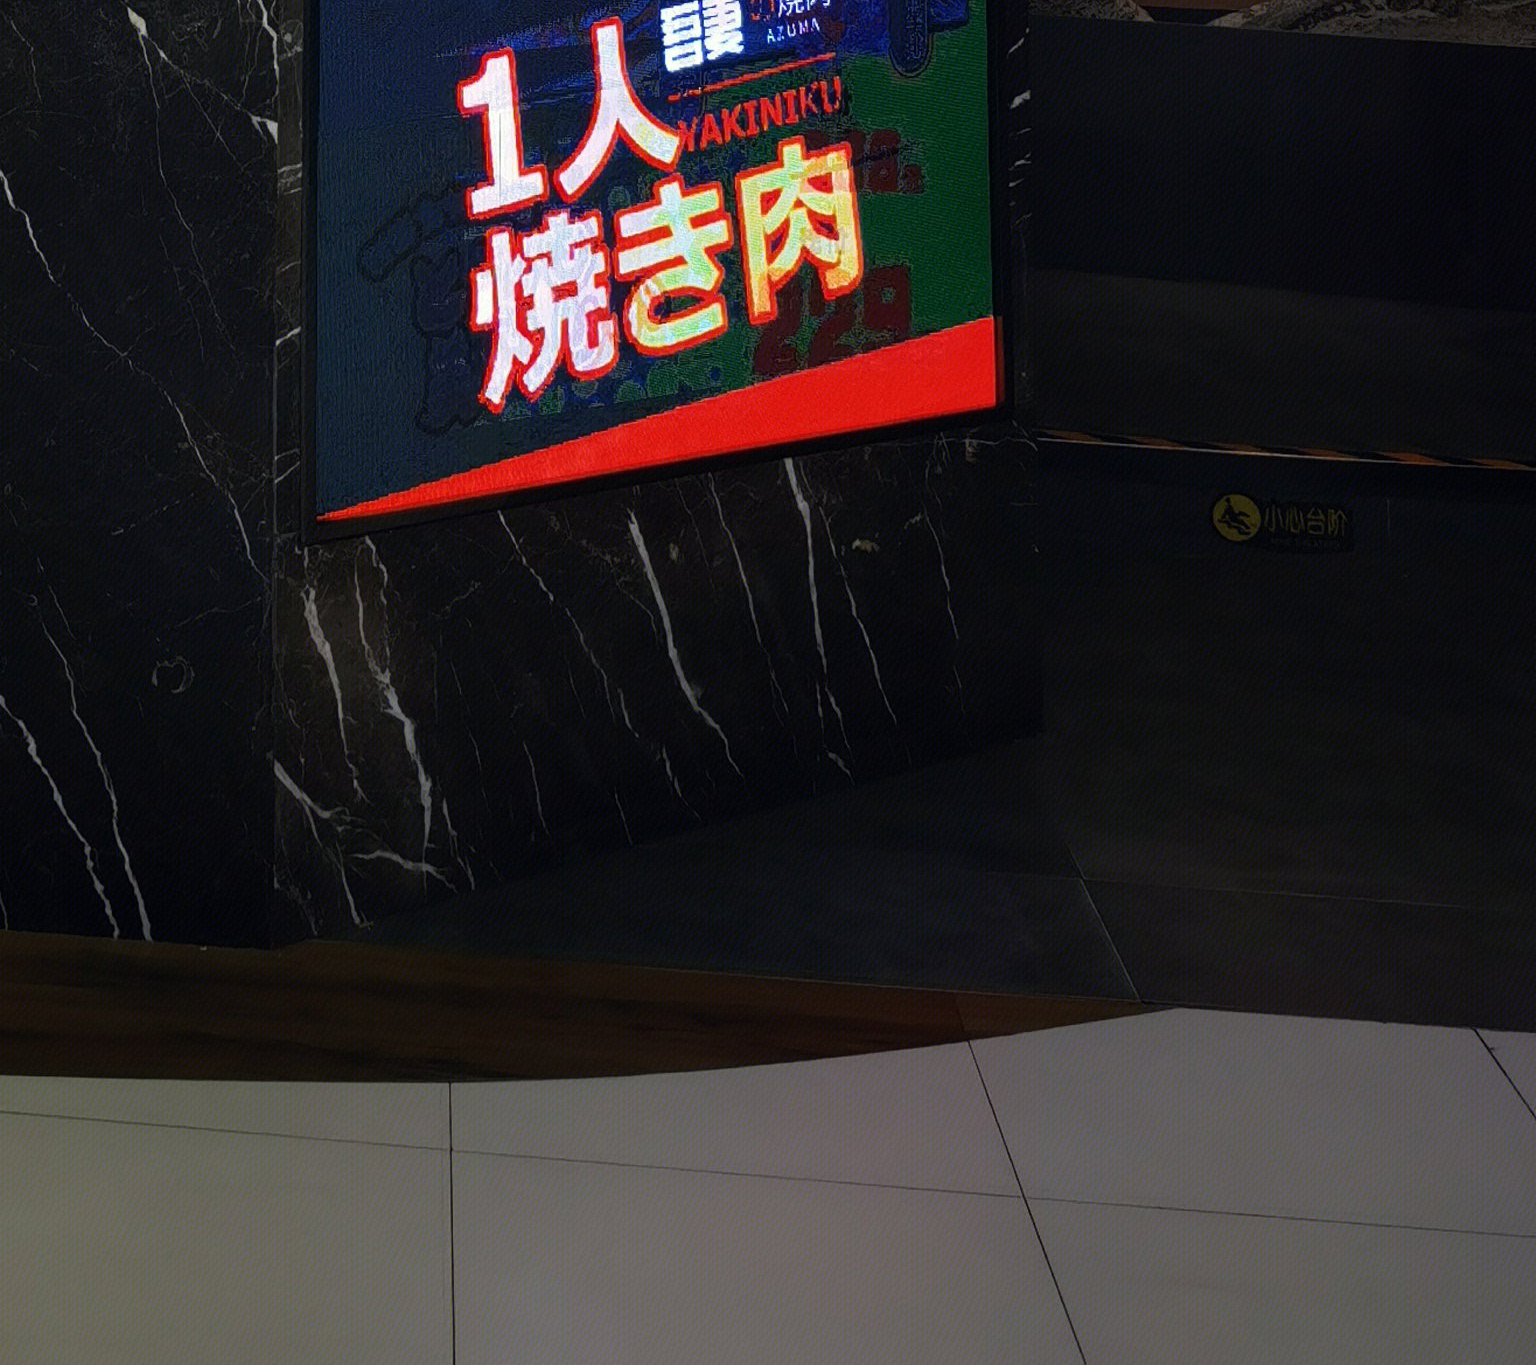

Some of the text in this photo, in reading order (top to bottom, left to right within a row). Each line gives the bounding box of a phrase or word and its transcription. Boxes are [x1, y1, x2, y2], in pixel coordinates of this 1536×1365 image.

[458, 16, 680, 218] 1人
[678, 76, 842, 153] YAKINIKU
[471, 137, 863, 412] 焼き肉
